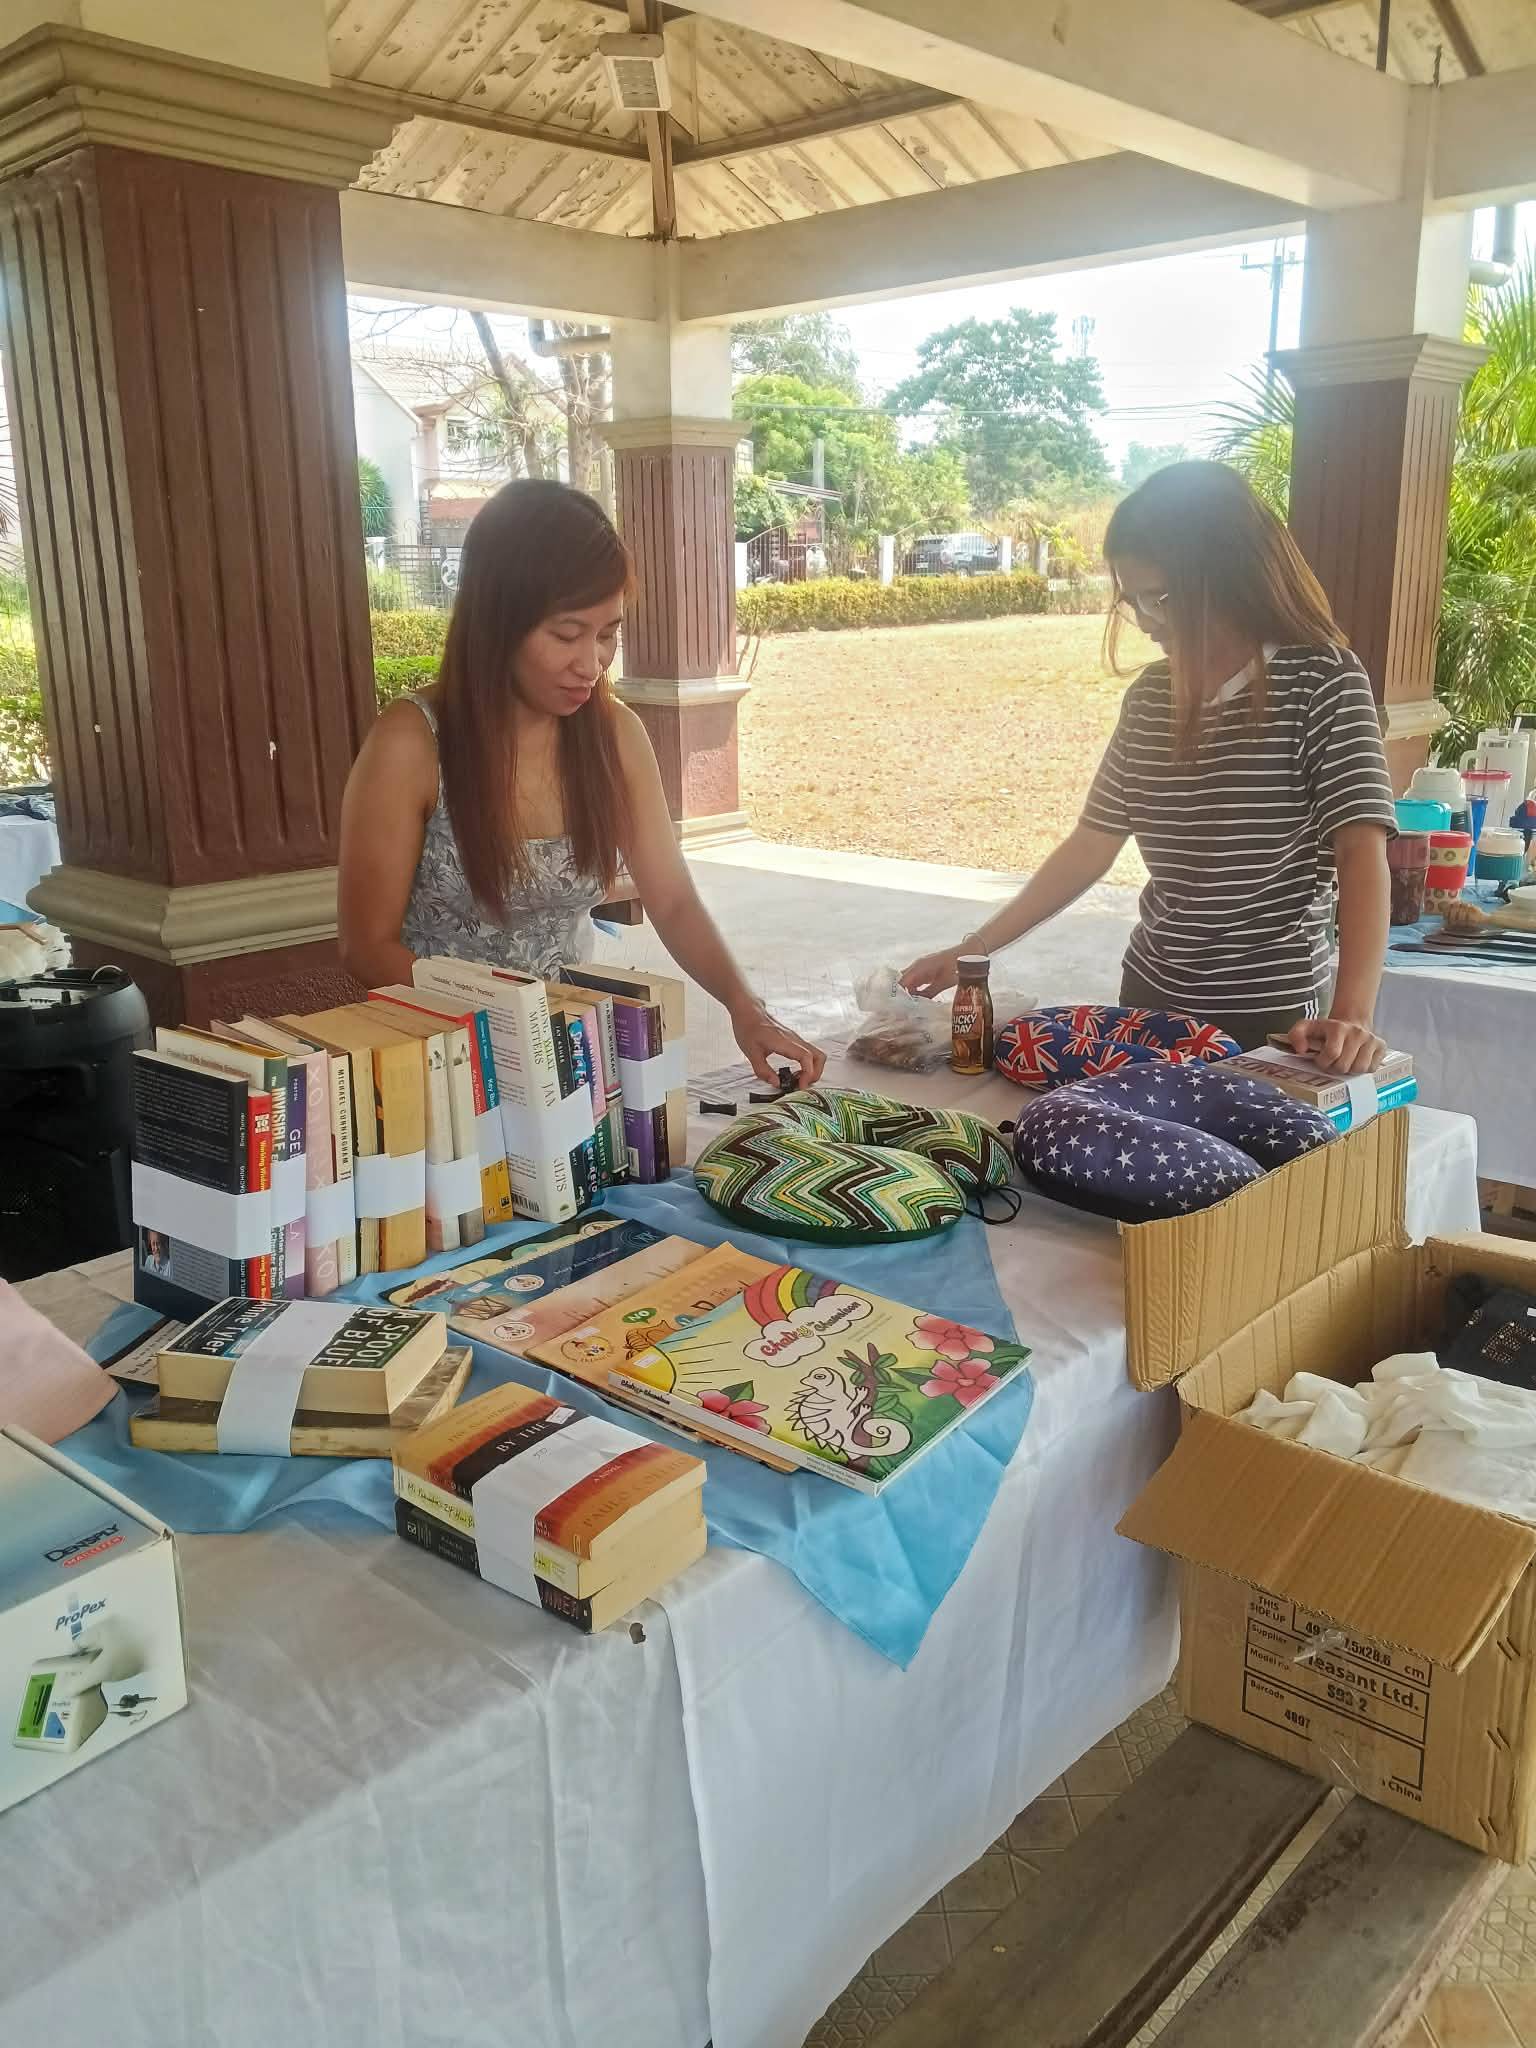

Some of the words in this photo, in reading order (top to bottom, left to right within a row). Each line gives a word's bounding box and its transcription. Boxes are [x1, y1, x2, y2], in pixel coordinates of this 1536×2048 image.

[953, 1013, 978, 1026] UCKY
[528, 1010, 544, 1065] MATTERS
[337, 1069, 346, 1106] MICHAEL
[271, 1087, 287, 1151] INVISIBLE
[340, 1109, 349, 1164] CUNNINGHAM
[233, 1301, 278, 1324] Anne
[359, 1309, 391, 1326] OF
[396, 1312, 420, 1320] A
[629, 1310, 650, 1321] NO
[201, 1326, 249, 1353] Tyler
[314, 1329, 372, 1366] BLUE
[346, 1323, 410, 1366] SPOOL
[496, 1438, 517, 1453] BY
[519, 1423, 551, 1439] THE
[55, 1598, 107, 1631] ProPex
[1250, 1602, 1271, 1617] SIDE
[1272, 1612, 1286, 1623] UP
[1258, 1595, 1280, 1611] THIS
[1251, 1623, 1288, 1644] Supplier
[1250, 1647, 1277, 1665] Model
[1403, 1664, 1425, 1680] cm
[1250, 1680, 1286, 1701] Barcode
[1382, 1681, 1419, 1712] Ltd.
[1388, 1779, 1423, 1803] China
